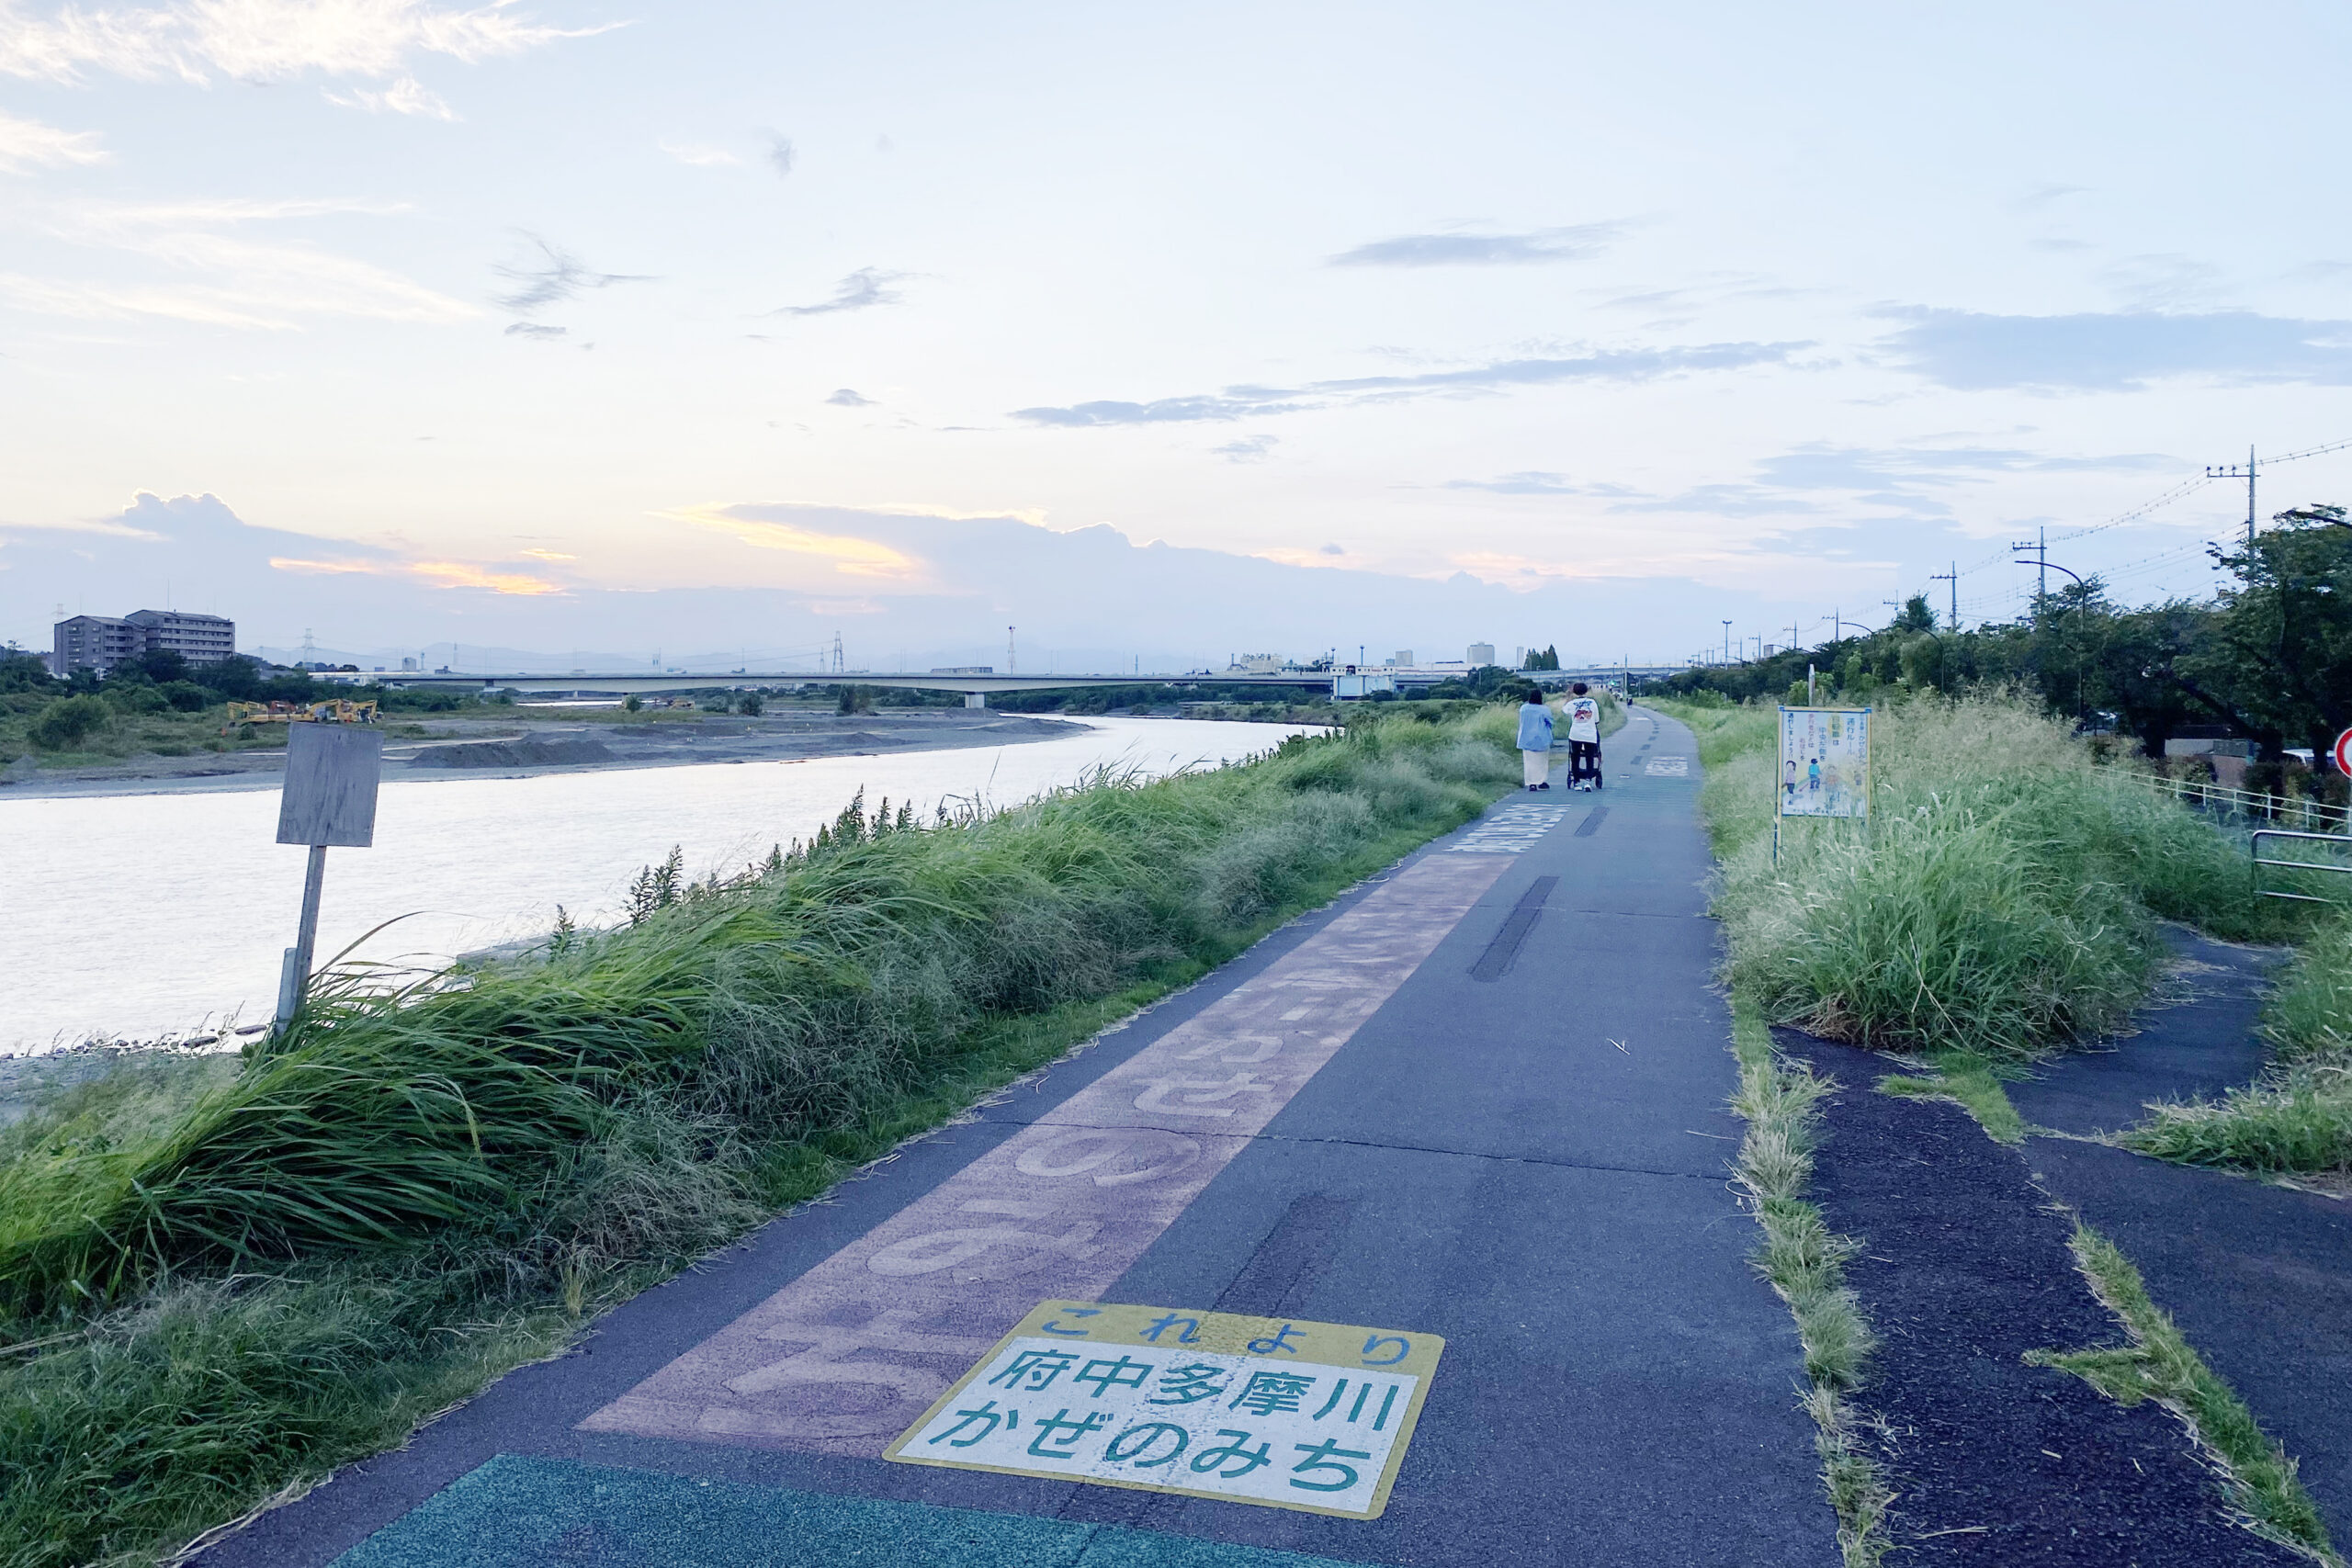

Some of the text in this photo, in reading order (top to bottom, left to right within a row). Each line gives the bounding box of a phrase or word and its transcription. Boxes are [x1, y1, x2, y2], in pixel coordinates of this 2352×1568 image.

[1042, 1306, 1412, 1368] これより
[989, 1348, 1401, 1433] 府中多摩川
[928, 1400, 1373, 1494] かぜのみち
